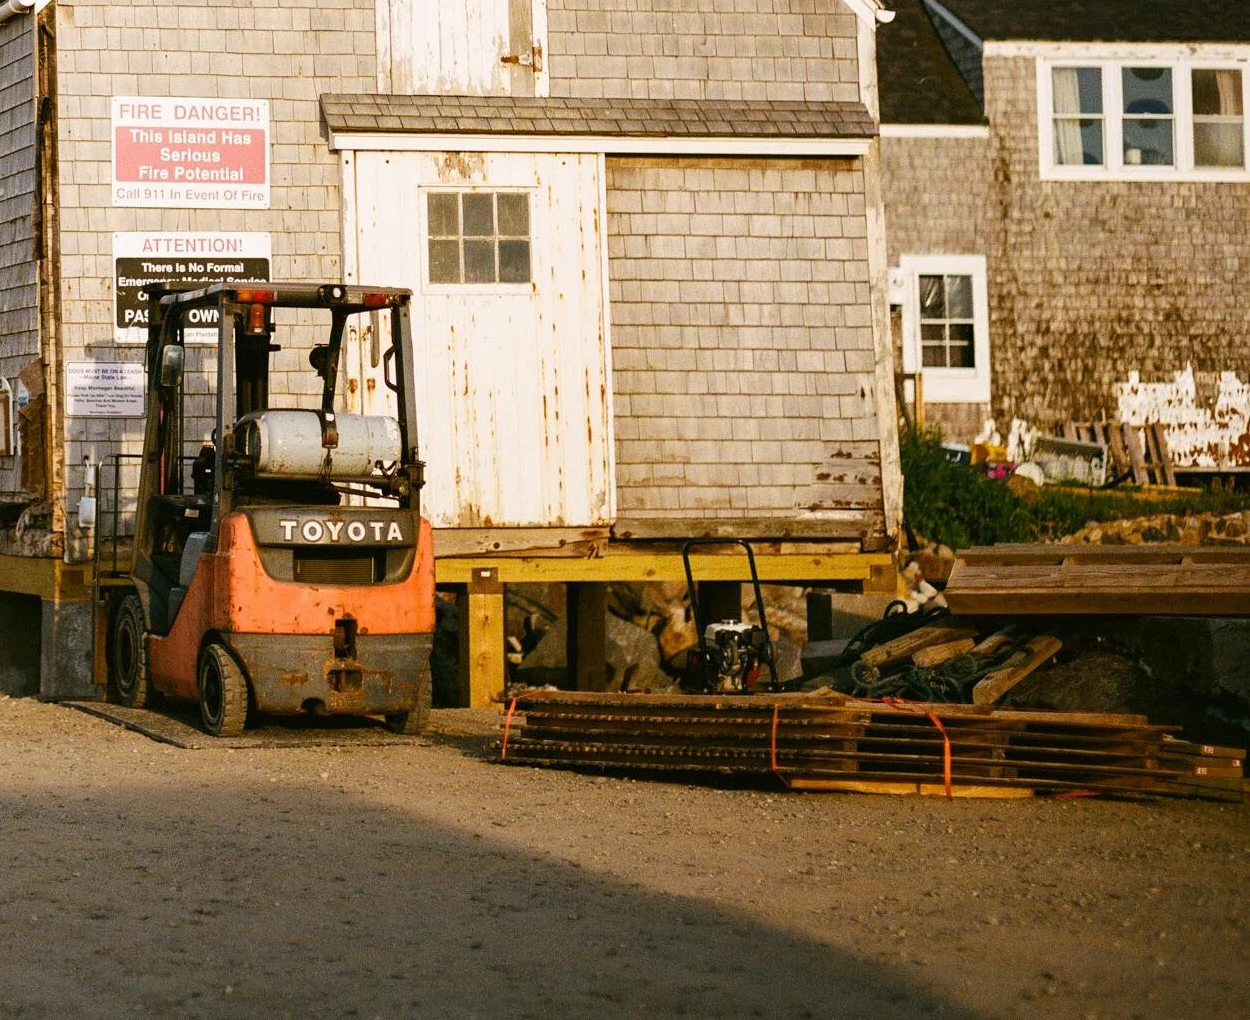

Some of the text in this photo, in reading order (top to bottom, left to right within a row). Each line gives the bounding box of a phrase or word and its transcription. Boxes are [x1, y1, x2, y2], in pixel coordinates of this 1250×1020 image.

[119, 104, 261, 122] FIRE DANGER!
[129, 129, 252, 145] This Island Has
[160, 148, 221, 162] Serious
[138, 165, 244, 181] Fire Potential
[116, 188, 265, 201] Call 911 In Event Of Fire
[142, 238, 243, 253] ATTENTION!
[141, 262, 244, 273] There Is No Formal
[279, 520, 403, 542] TOYOTA
